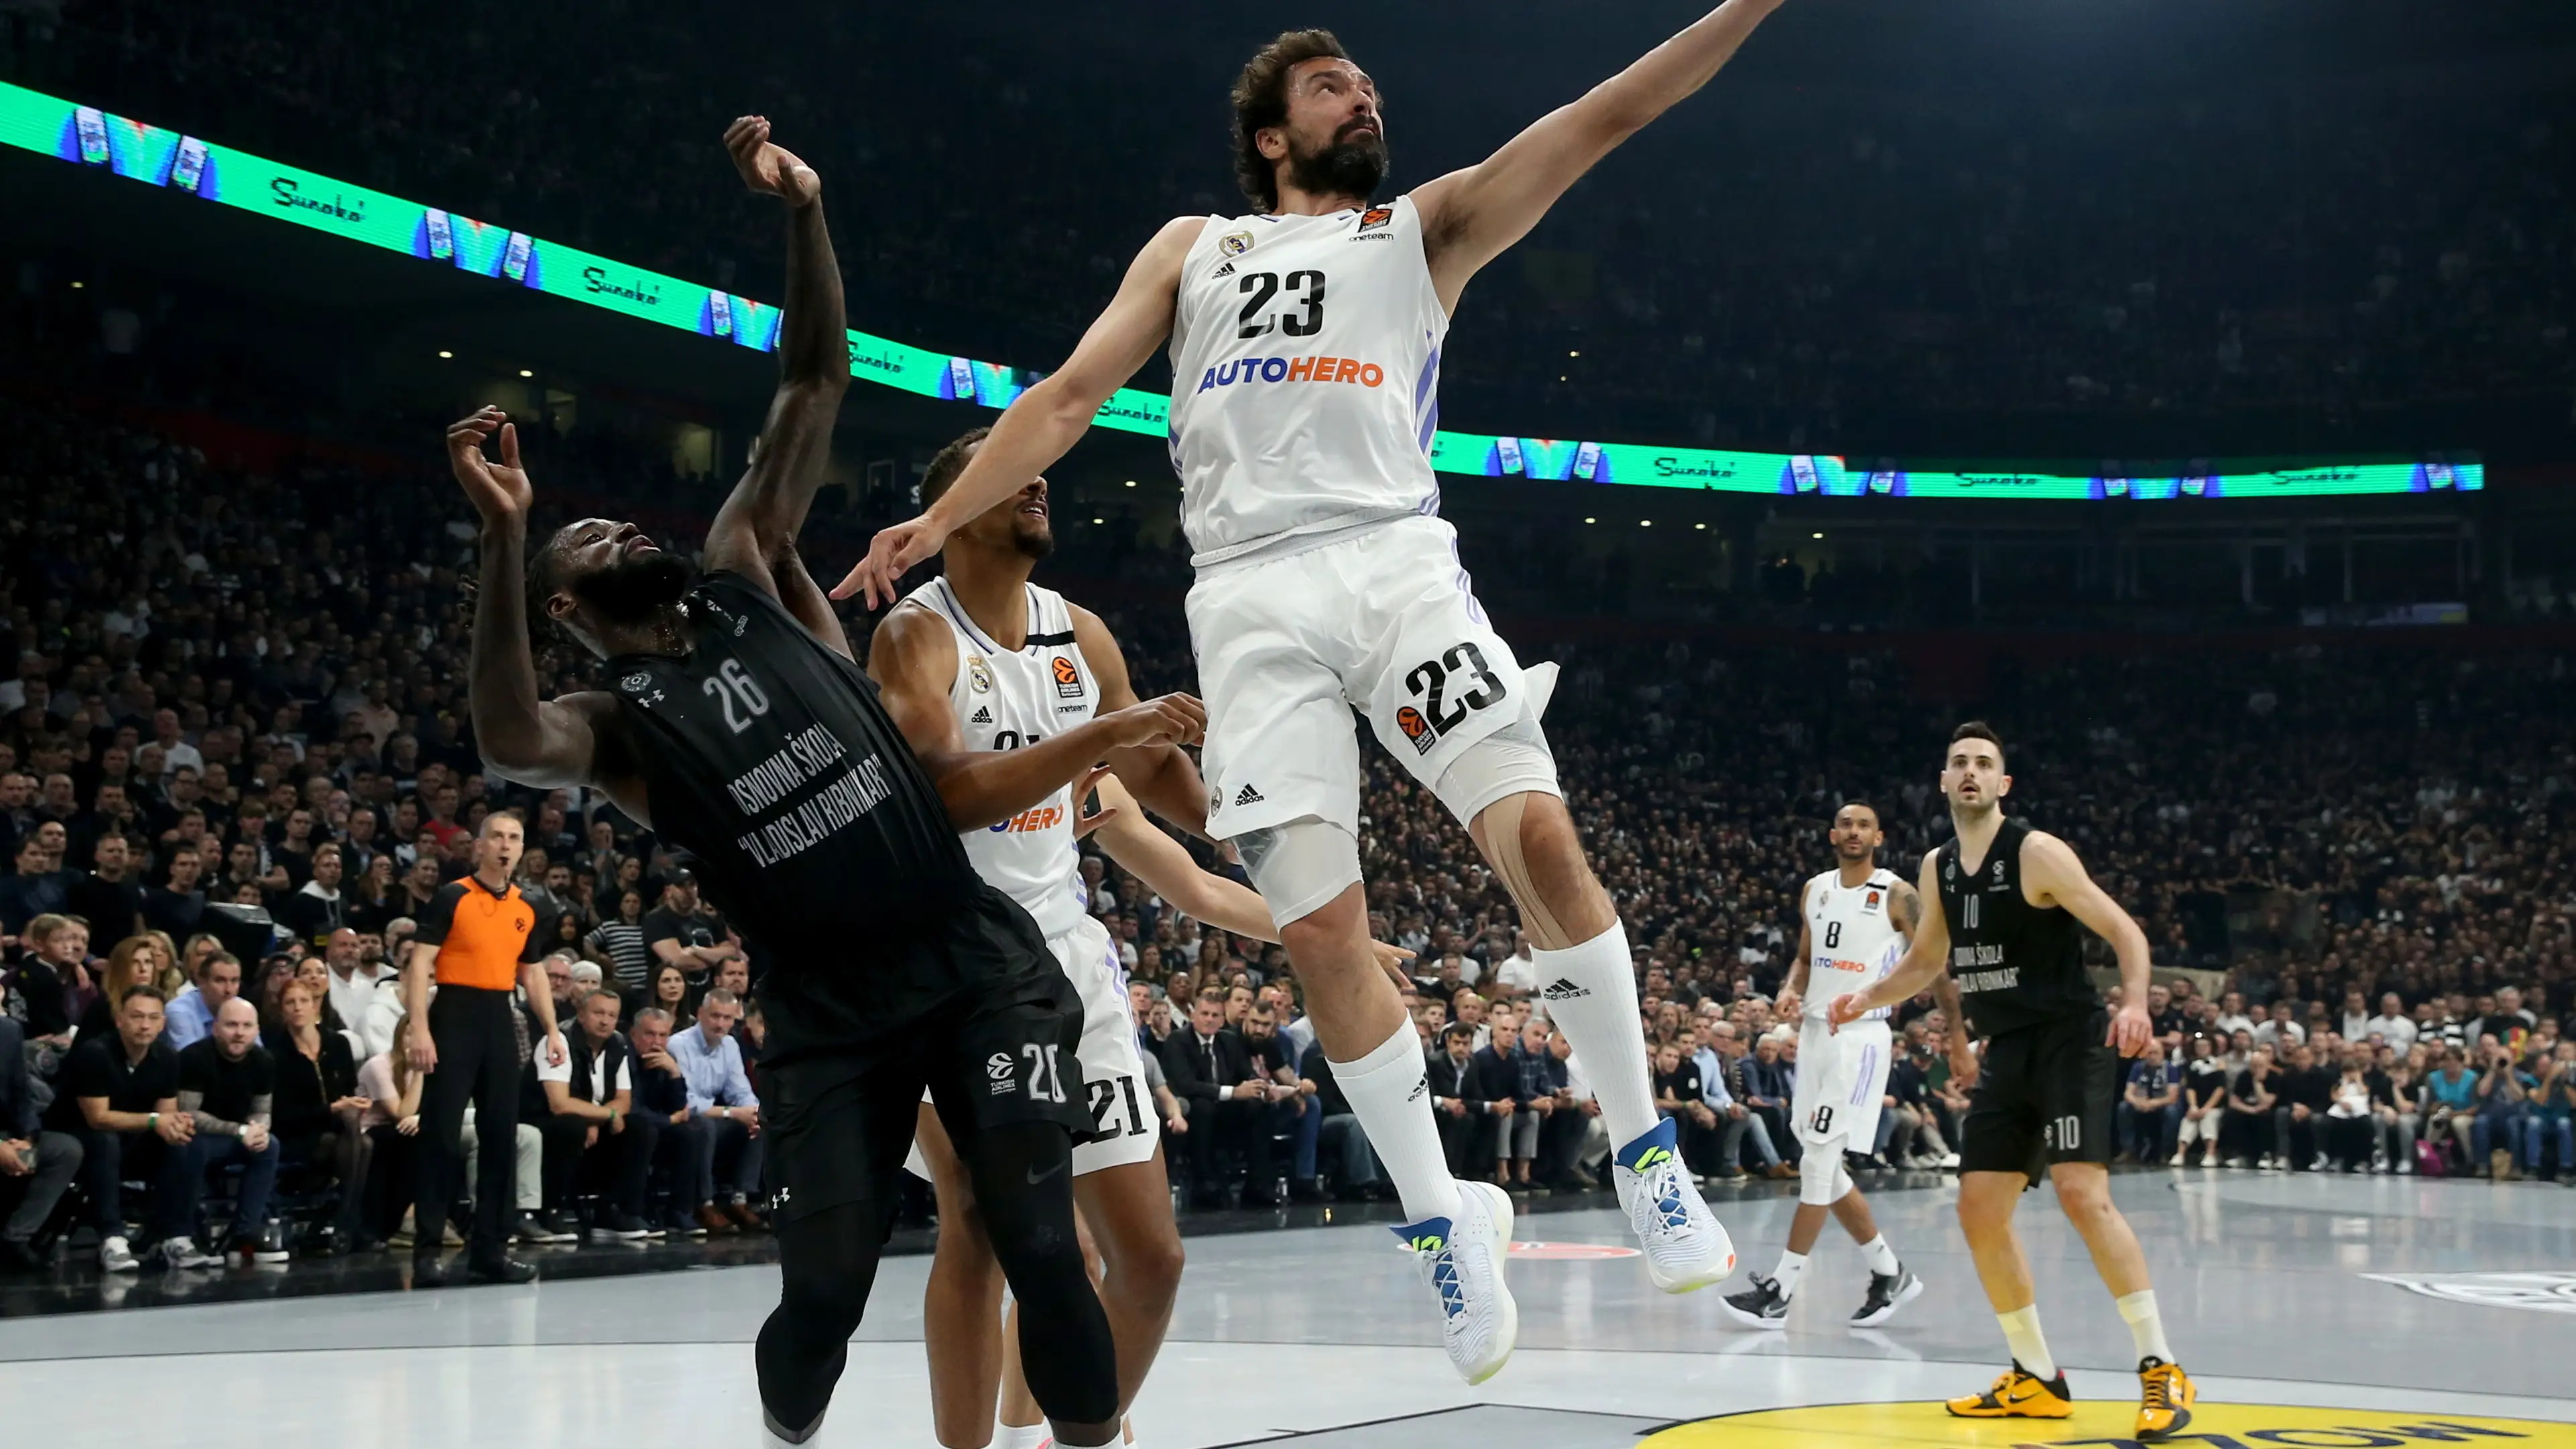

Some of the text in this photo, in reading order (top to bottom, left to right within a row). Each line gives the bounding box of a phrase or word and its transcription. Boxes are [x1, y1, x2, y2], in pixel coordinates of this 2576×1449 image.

[1349, 233, 1394, 241] oneteam
[1238, 269, 1327, 339] 23
[1197, 356, 1384, 395] AUTOHERO
[702, 657, 770, 735] 26
[1406, 642, 1506, 737] 23
[727, 720, 847, 816] OSNOVNA ŠKOLA
[1235, 794, 1265, 806] adidas
[1963, 893, 1979, 930] 10
[1825, 920, 1842, 949] 8
[1544, 988, 1591, 1001] adidas
[1084, 1075, 1148, 1144] 21
[1815, 1105, 1833, 1134] 8
[2054, 1115, 2080, 1151] 10
